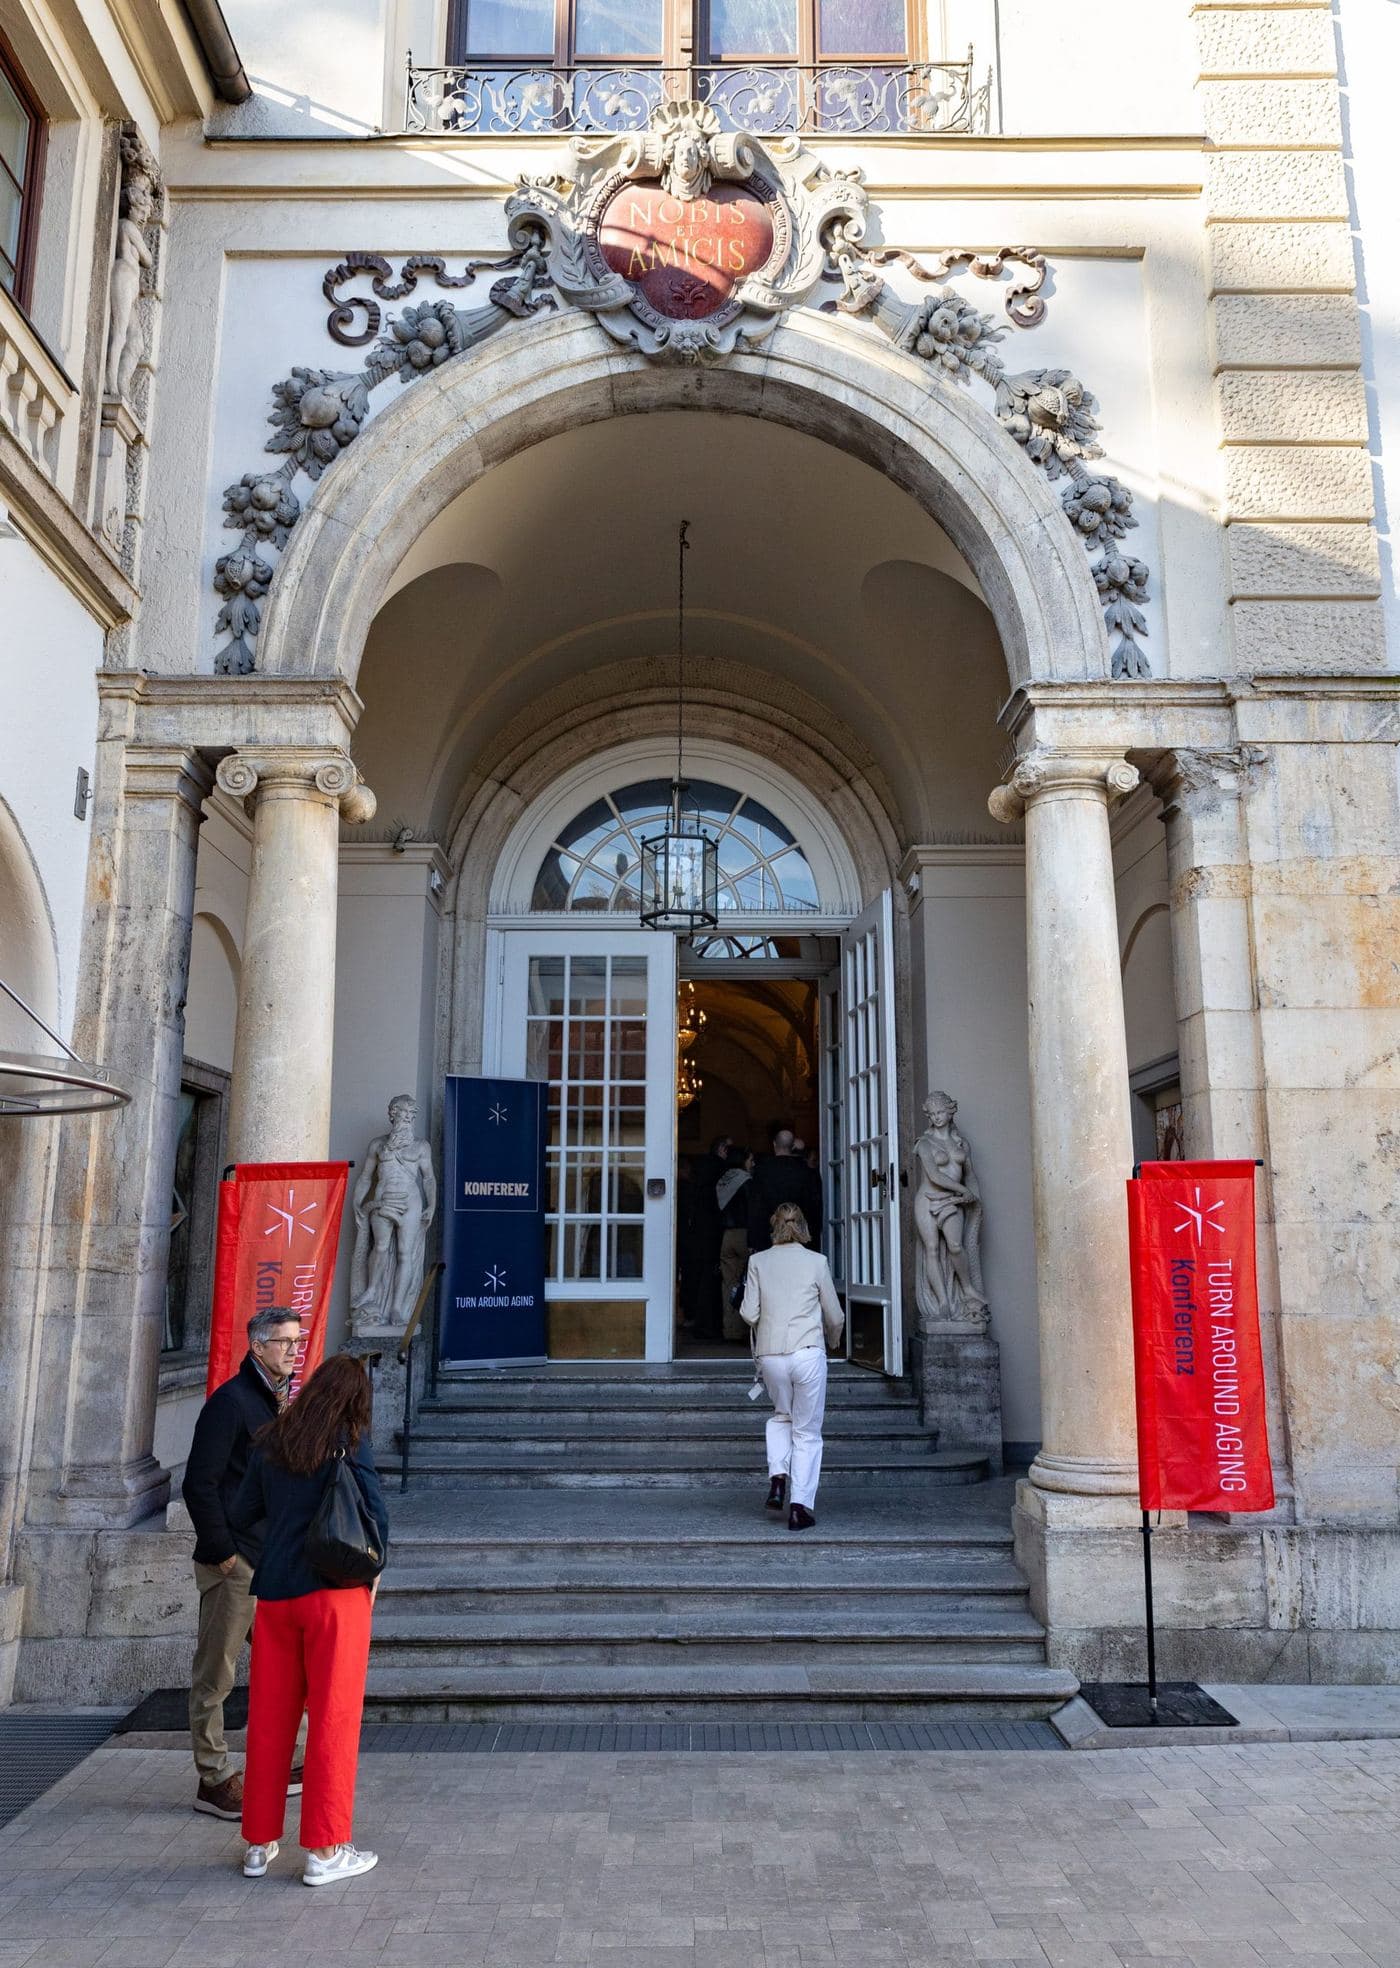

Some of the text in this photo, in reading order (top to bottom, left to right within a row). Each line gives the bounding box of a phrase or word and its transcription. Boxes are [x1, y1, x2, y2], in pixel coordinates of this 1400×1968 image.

[629, 199, 746, 228] NOBIS
[675, 225, 696, 237] ET
[627, 238, 746, 276] AMICIS
[464, 1181, 529, 1197] KONFERENZ
[291, 1261, 317, 1317] TURN
[455, 1295, 534, 1309] TURN AROUND AGING
[1170, 1259, 1197, 1376] Konferenz
[1207, 1258, 1247, 1492] TURN AROUND AGING
